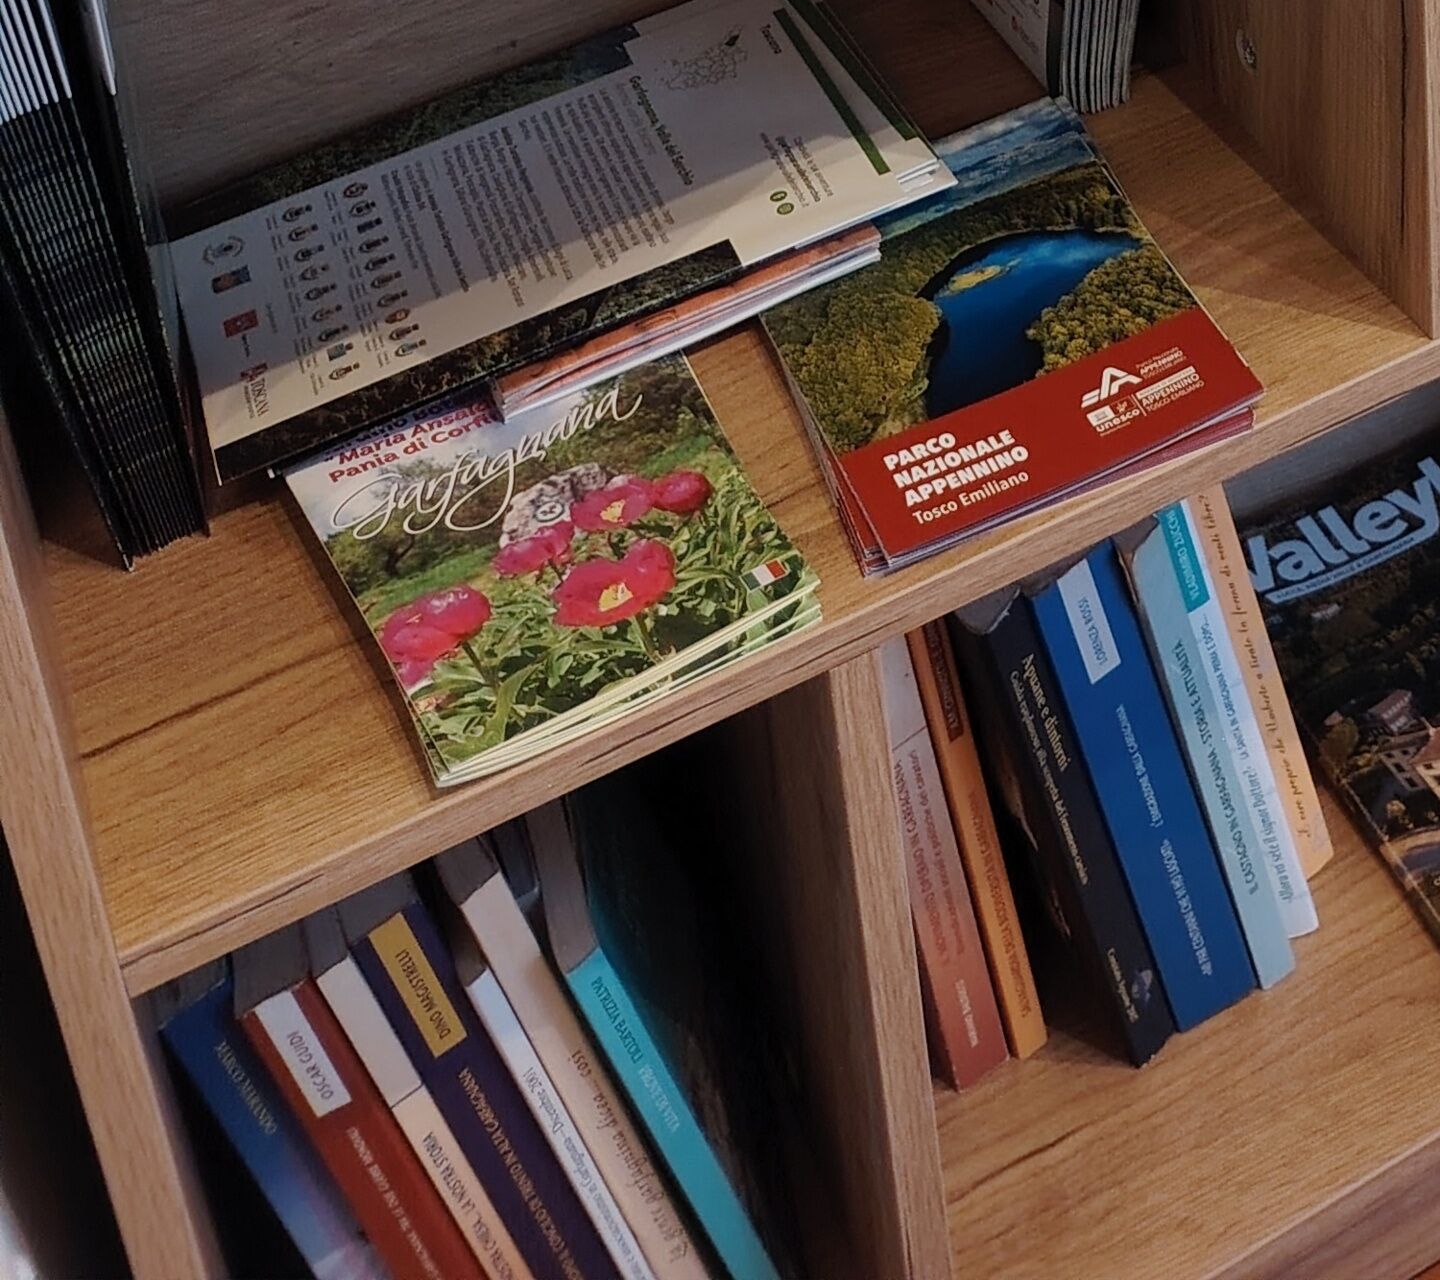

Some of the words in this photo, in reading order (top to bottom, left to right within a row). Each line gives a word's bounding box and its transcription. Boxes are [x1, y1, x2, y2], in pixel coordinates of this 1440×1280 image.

[1140, 350, 1184, 376] APPENNINO
[1141, 373, 1200, 407] APPENNINO
[1096, 408, 1140, 433] unesco
[328, 451, 401, 484] Pania
[403, 438, 428, 457] di
[330, 388, 643, 540] Garfagnana
[883, 432, 957, 473] PARCO
[893, 429, 1017, 490] NAZIONALE
[903, 444, 1031, 508] APPENNINO
[912, 495, 959, 527] Tosco
[959, 468, 1031, 509] Emiliano
[1164, 508, 1186, 547] ZUCCHI
[1176, 546, 1202, 600] VLADIMIRO
[1076, 596, 1095, 624] ROSSI
[1085, 621, 1109, 666] LORENZA
[1168, 638, 1199, 699] ATTUALITÀ
[1017, 651, 1051, 708] Apuane
[1041, 715, 1073, 772] dintorni
[1191, 703, 1213, 744] STORIA
[1203, 746, 1237, 818] GARFAGNANA
[1230, 829, 1257, 884] CASTAGNO
[392, 946, 440, 1013] MAGISTRELLI
[427, 1008, 453, 1040] DINO
[588, 975, 626, 1024] PATRIZIA
[611, 1017, 647, 1064] BARTOLI
[284, 1028, 315, 1065] GUIDI
[304, 1061, 336, 1102] OSCAR
[454, 1066, 502, 1134] GARFAGNANA
[418, 1130, 450, 1169] STORIA
[488, 1127, 513, 1155] ALTA
[437, 1162, 470, 1204] NOSTRA
[507, 1161, 539, 1202] TRENTO
[600, 1125, 668, 1211] garfagnina
